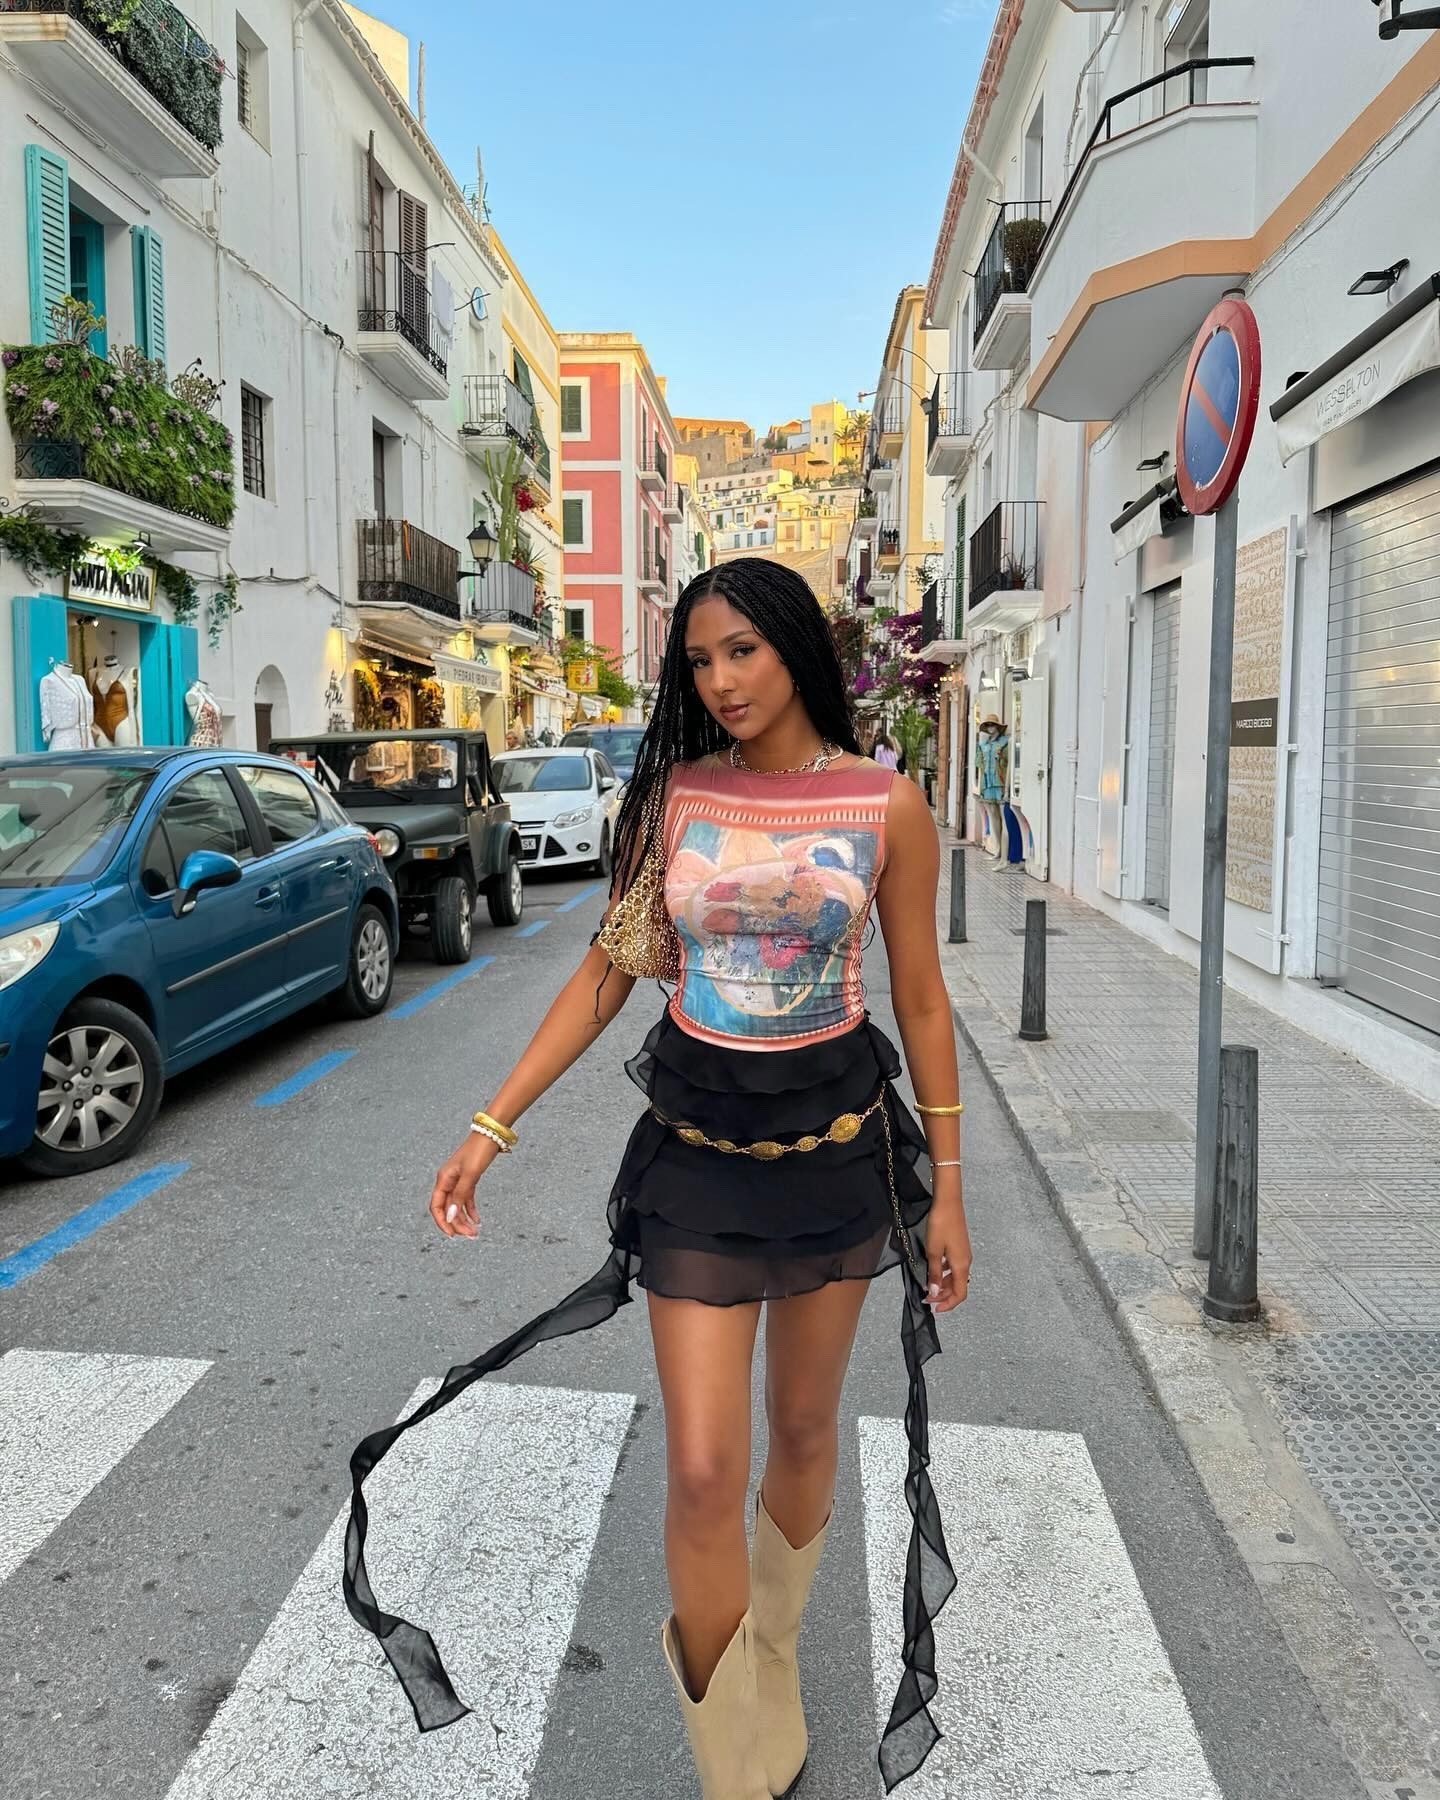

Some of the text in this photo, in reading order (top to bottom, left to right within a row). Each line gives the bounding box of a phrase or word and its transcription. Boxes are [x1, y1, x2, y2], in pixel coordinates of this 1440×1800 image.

[1316, 360, 1381, 417] WESSELTON
[71, 562, 108, 594] SANTA
[1235, 718, 1273, 729] MARCO BICEGO
